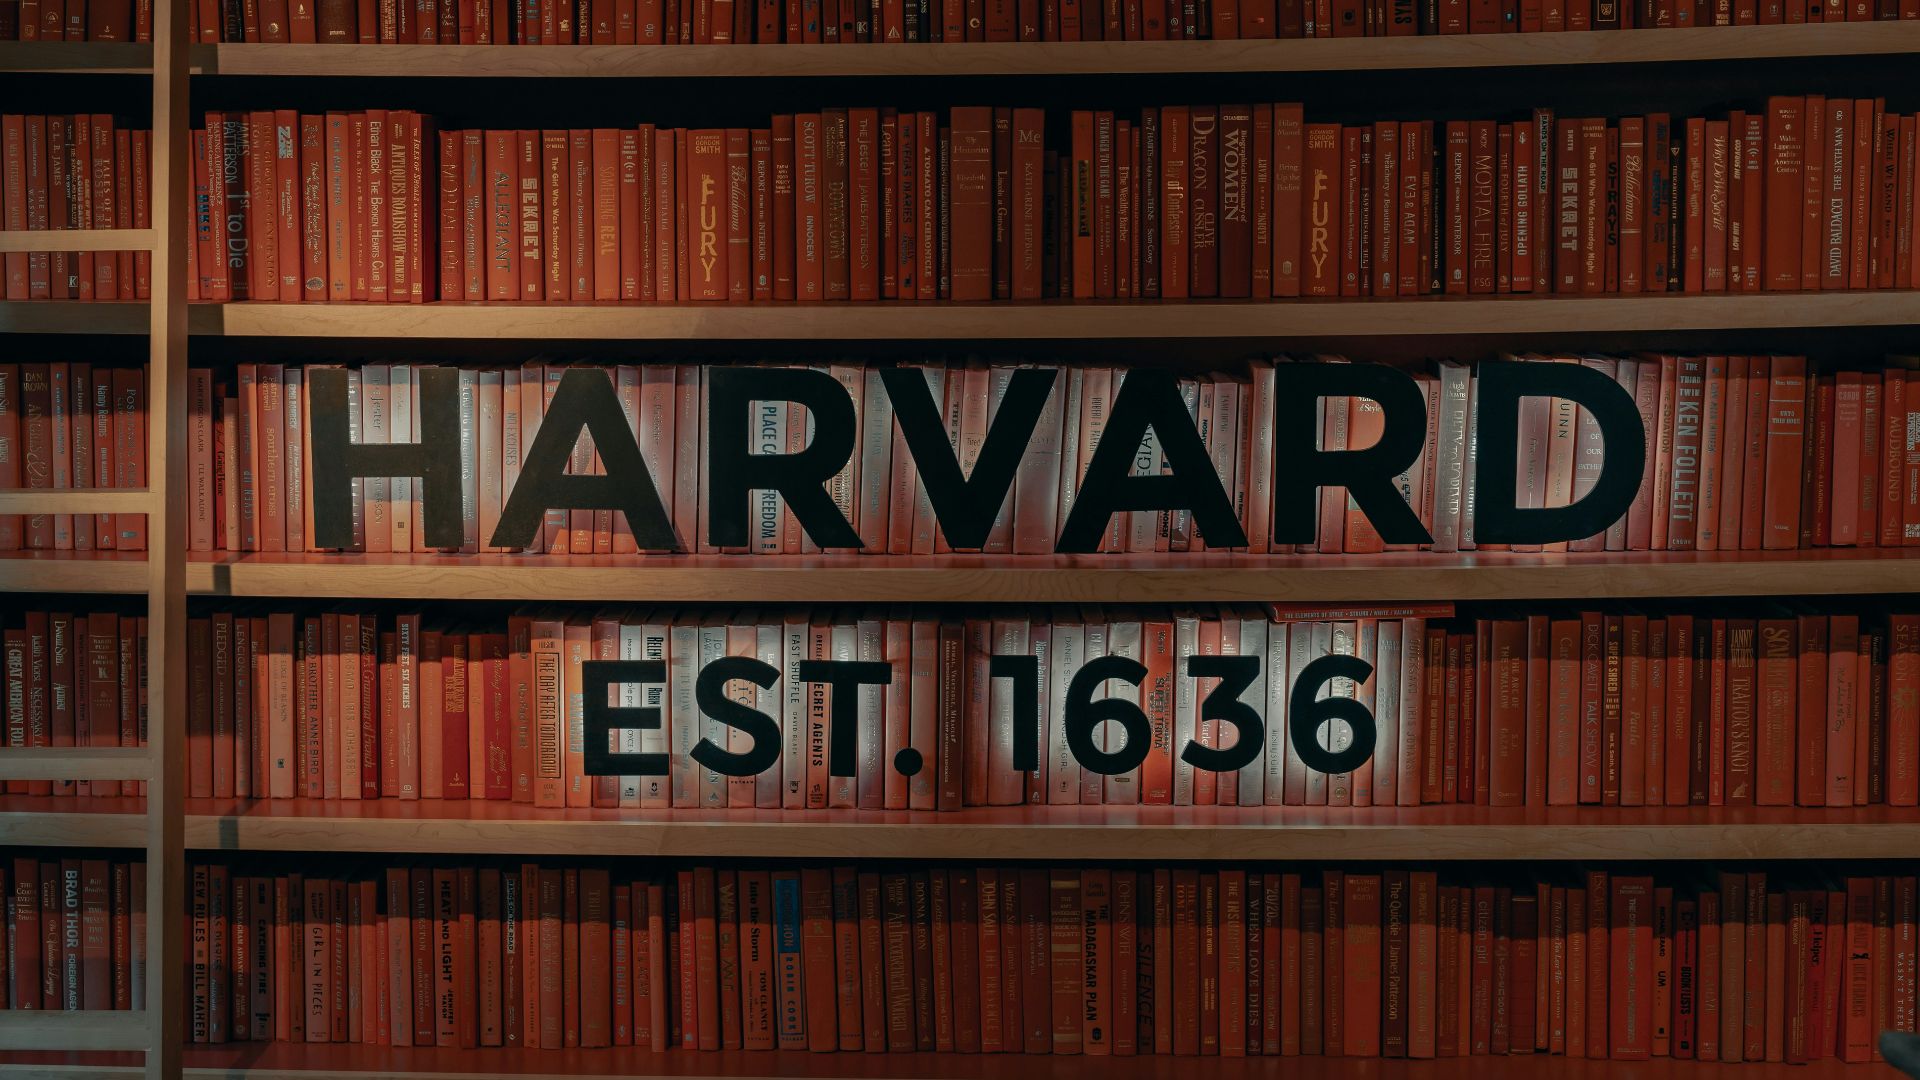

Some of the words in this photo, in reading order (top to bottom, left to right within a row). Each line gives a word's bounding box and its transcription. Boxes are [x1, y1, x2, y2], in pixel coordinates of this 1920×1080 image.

[224, 121, 237, 184] PATTERSON
[237, 121, 250, 156] JAMES
[695, 146, 720, 154] SMITH
[803, 121, 815, 159] SCOTT
[880, 122, 894, 159] Lean
[1018, 130, 1041, 143] Me
[1192, 115, 1215, 190] DRAGON
[1834, 127, 1843, 146] MAN
[390, 144, 406, 194] ANTIQUES
[882, 162, 894, 176] In
[1224, 129, 1239, 222] WOMEN
[1382, 152, 1391, 190] Treachery
[1454, 152, 1462, 184] REPORT
[1834, 148, 1842, 172] SIXTH
[227, 191, 250, 209] 1st
[804, 162, 815, 203] TUROW
[1474, 155, 1491, 227] MORTAL
[1517, 166, 1527, 207] GOLIATH
[1833, 174, 1842, 191] THE
[522, 178, 538, 259] SEKRET
[1383, 199, 1391, 235] Beautiful
[1562, 167, 1577, 251] SEKRET
[1607, 162, 1617, 245] STRAYS
[1830, 198, 1843, 244] BALDACCI
[228, 214, 244, 232] to
[392, 197, 406, 252] ROADSHOW
[699, 177, 718, 282] FURY
[806, 215, 814, 262] INNOCENT
[1193, 199, 1205, 248] CUSSLER
[1204, 212, 1214, 247] CLIVE
[1311, 171, 1328, 278] FURY
[1517, 211, 1527, 256] OPENING
[229, 238, 248, 268] Die
[1381, 237, 1390, 262] Things
[1474, 233, 1491, 269] FIRE
[1829, 248, 1842, 277] DAVID
[395, 255, 406, 283] PRIMER
[96, 385, 107, 407] Nanny
[1680, 388, 1700, 397] TWIN
[97, 410, 108, 437] Returns
[506, 412, 516, 426] NO
[762, 406, 776, 439] PLACE
[1662, 404, 1671, 453] EQUATION
[1677, 401, 1699, 436] KEN
[216, 451, 224, 473] Going
[266, 428, 278, 482] southern
[309, 361, 1646, 552] HARVARD
[506, 428, 516, 466] EXCUSES
[1888, 416, 1900, 502] MUDBOUND
[217, 473, 225, 496] Home
[268, 485, 277, 517] cross
[1673, 446, 1696, 522] FOLLETT
[32, 636, 41, 657] Judith
[216, 623, 227, 675] PLEDGED
[401, 624, 409, 647] SIXTY
[790, 634, 800, 657] FAST
[1587, 624, 1598, 650] DICK
[1607, 640, 1618, 666] SUPER
[7, 649, 22, 678] GREAT
[33, 659, 43, 682] Viorst
[539, 658, 554, 672] THE
[1501, 646, 1509, 663] THE
[539, 675, 555, 692] DAY
[790, 661, 800, 704] SHUFFLE
[1500, 666, 1509, 708] SWALLOW
[1587, 653, 1597, 692] CAVETT
[1607, 668, 1618, 691] SHRED
[8, 679, 23, 724] AMERICAN
[33, 688, 43, 737] NECESSARY
[402, 683, 410, 708] INCHES
[540, 696, 556, 720] AFTER
[813, 684, 822, 718] ECRET
[1155, 678, 1164, 713] SUPER
[1587, 700, 1597, 724] TALK
[1732, 677, 1751, 738] TRAITOR'S
[310, 716, 318, 745] ANNE
[582, 656, 923, 778] EST.
[991, 654, 1377, 776] 1636
[1154, 716, 1163, 749] TRIVIA
[310, 749, 319, 774] BIRD
[540, 722, 556, 773] TOMORROW
[812, 723, 822, 766] AGENTS
[1586, 728, 1596, 768] SHOW
[1731, 739, 1749, 775] KNOT
[65, 870, 78, 908] BRAD
[196, 872, 204, 898] NEW
[441, 881, 450, 914] HEAT
[750, 881, 759, 904] Into
[915, 882, 925, 919] DONNA
[982, 881, 995, 909] JOHN
[1390, 881, 1401, 901] The
[417, 880, 425, 951] CHARLESTON
[751, 907, 759, 925] the
[888, 912, 904, 928] An
[1266, 888, 1278, 918] 20/20
[1390, 902, 1402, 936] Quickie
[1478, 901, 1488, 940] citizen
[66, 911, 78, 947] THOR
[196, 904, 204, 942] RULES
[917, 922, 926, 950] LEON
[983, 913, 996, 936] SAUL
[1249, 898, 1259, 946] WHEN
[313, 928, 323, 957] GIRL
[751, 927, 760, 962] Storm
[1085, 910, 1096, 988] MADAGASKAR
[1389, 946, 1400, 974] James
[1477, 945, 1489, 964] girl
[68, 953, 76, 988] FOREIGN
[196, 963, 204, 990] BILL
[313, 963, 322, 976] IN
[442, 944, 451, 983] LIGHT
[785, 957, 794, 992] ROBIN
[888, 931, 907, 991] Inconvenient
[1249, 949, 1259, 987] LOVE
[68, 990, 76, 1010] AGEN
[312, 983, 322, 1016] PIECES
[1138, 944, 1152, 1026] SILENCE
[1388, 976, 1400, 1020] Patterson
[196, 996, 204, 1037] MAHER
[787, 1000, 796, 1030] COOK
[891, 994, 908, 1032] Woman
[1086, 992, 1097, 1021] PLAN
[1249, 993, 1259, 1026] DIES
